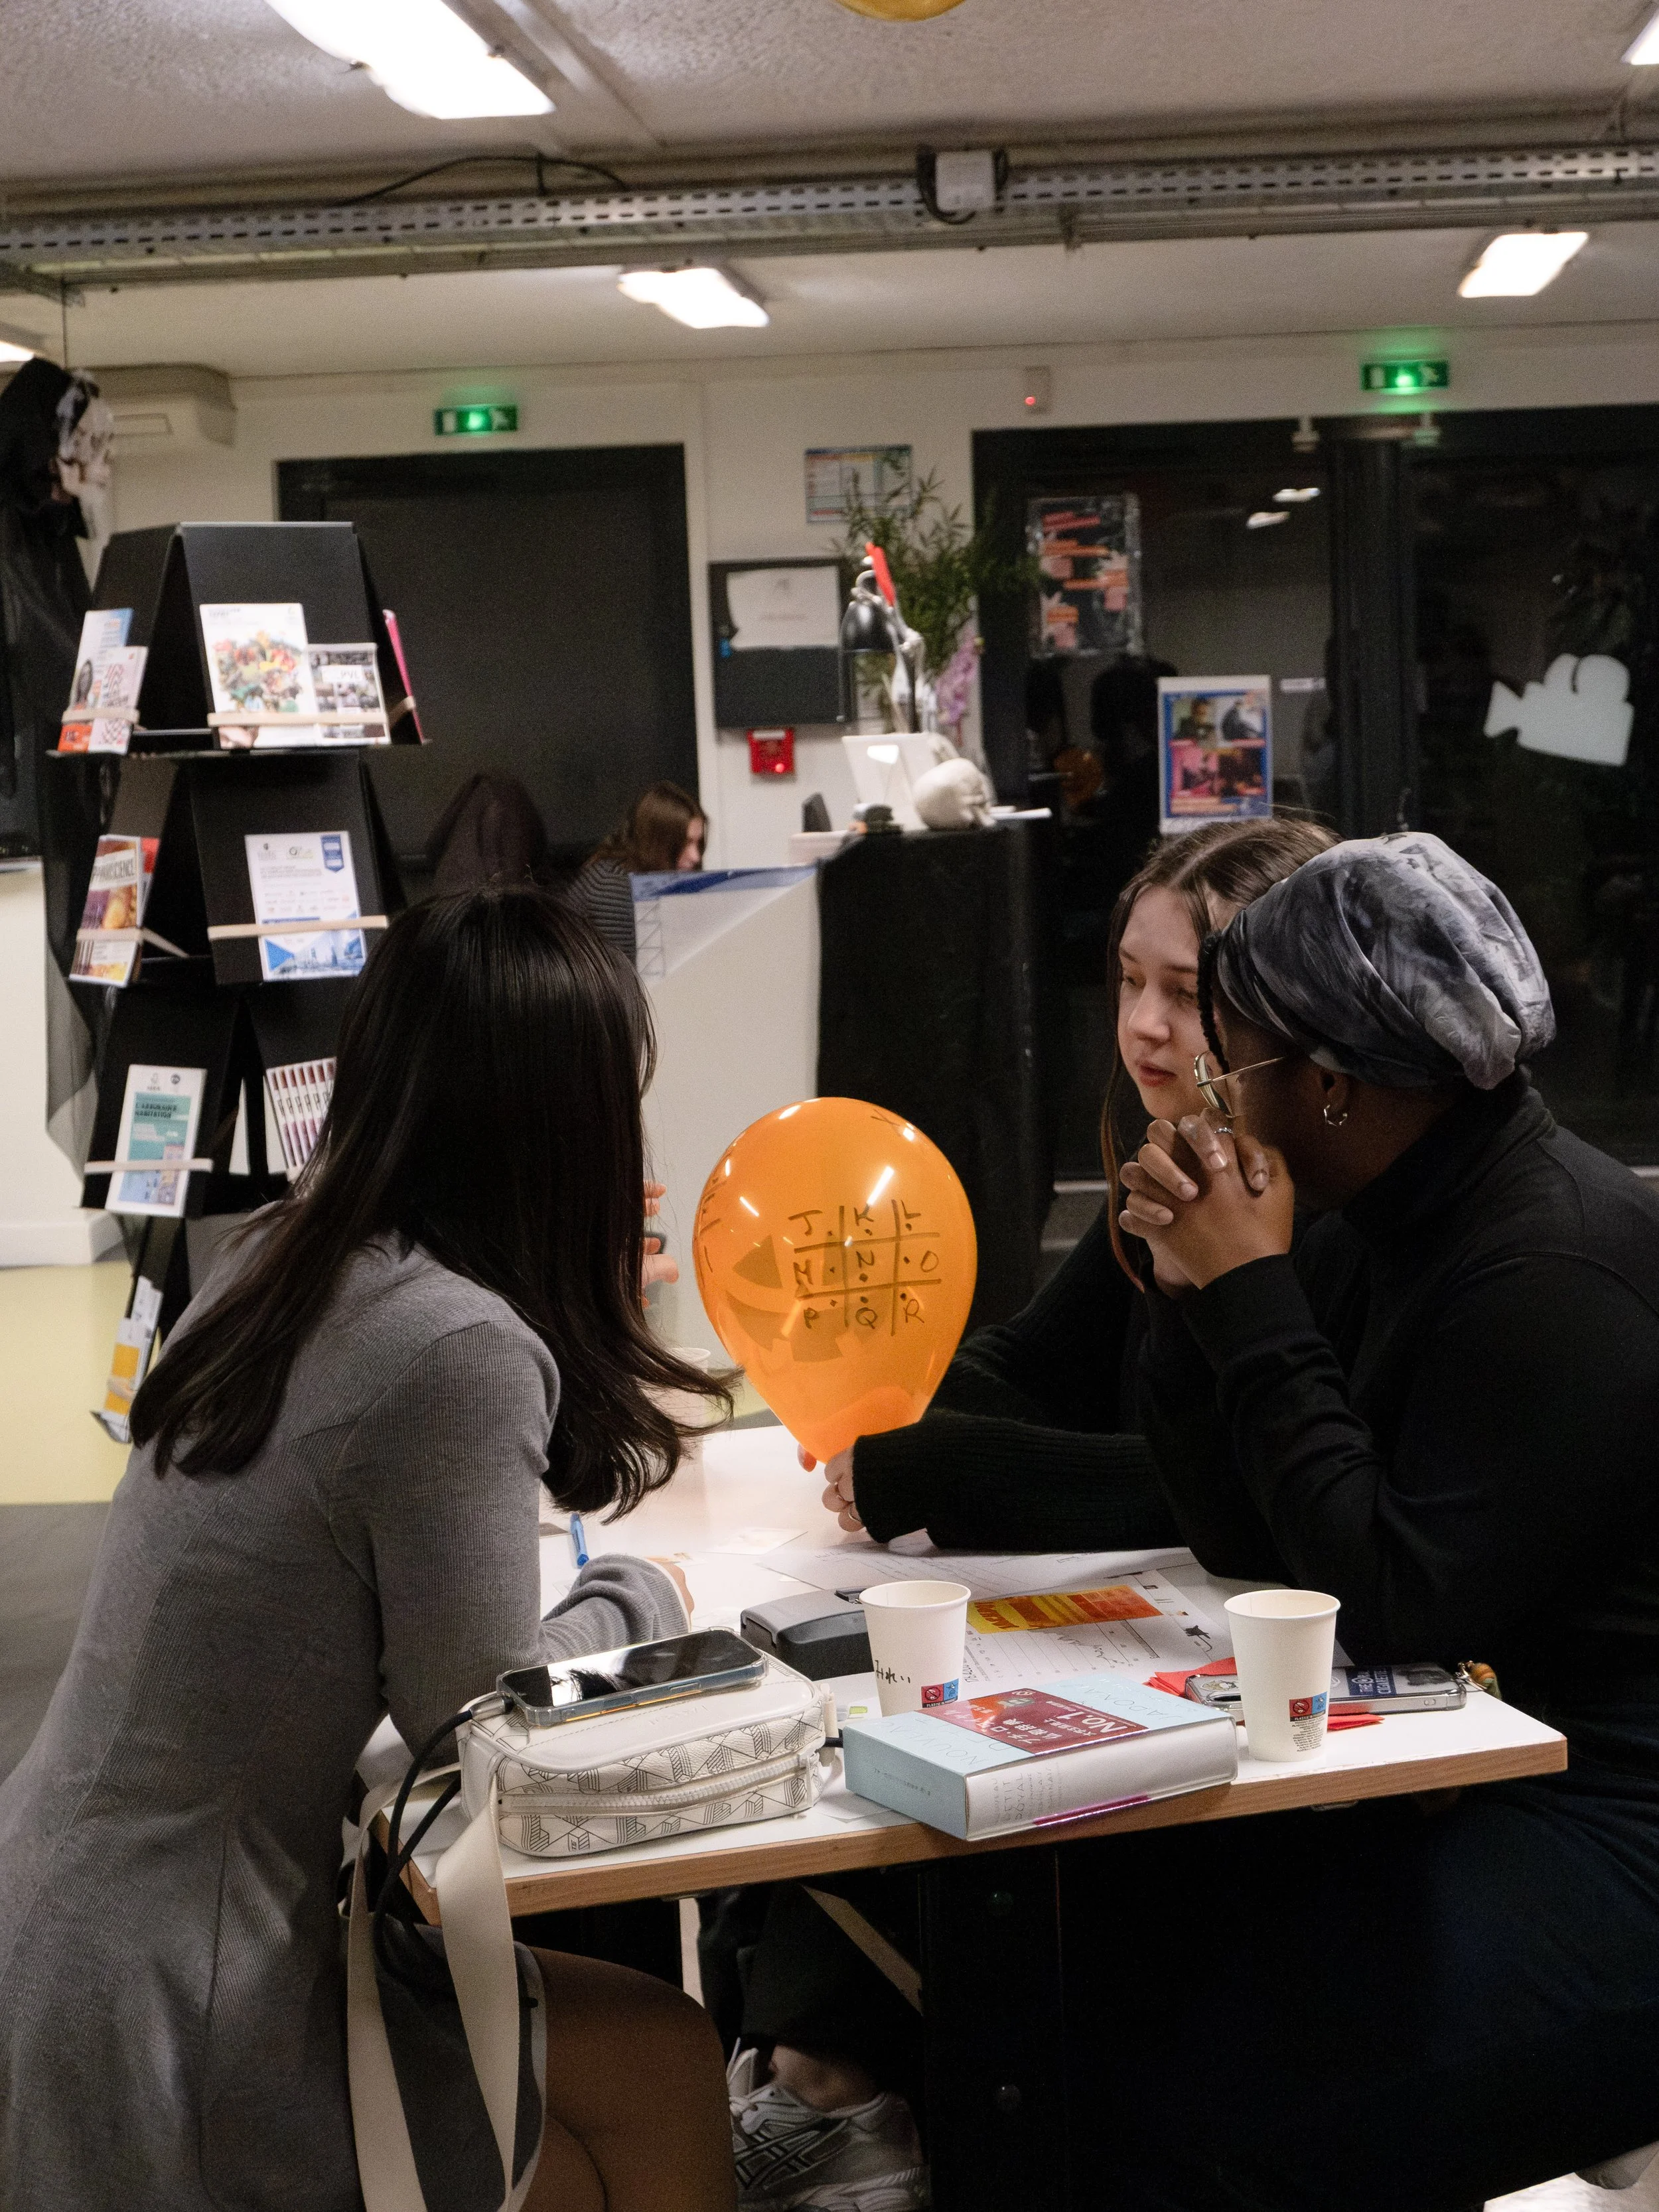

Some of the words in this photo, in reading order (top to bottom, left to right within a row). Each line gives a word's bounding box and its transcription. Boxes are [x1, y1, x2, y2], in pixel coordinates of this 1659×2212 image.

[853, 1204, 875, 1227] K
[901, 1200, 921, 1220] L
[855, 1250, 875, 1269] N
[803, 1307, 820, 1330] P
[855, 1307, 879, 1330] Q
[902, 1298, 925, 1324] R
[1376, 1667, 1392, 1694] CIGARETTE
[1056, 1711, 1128, 1733] No.1
[869, 1720, 989, 1765] NOUVEAU
